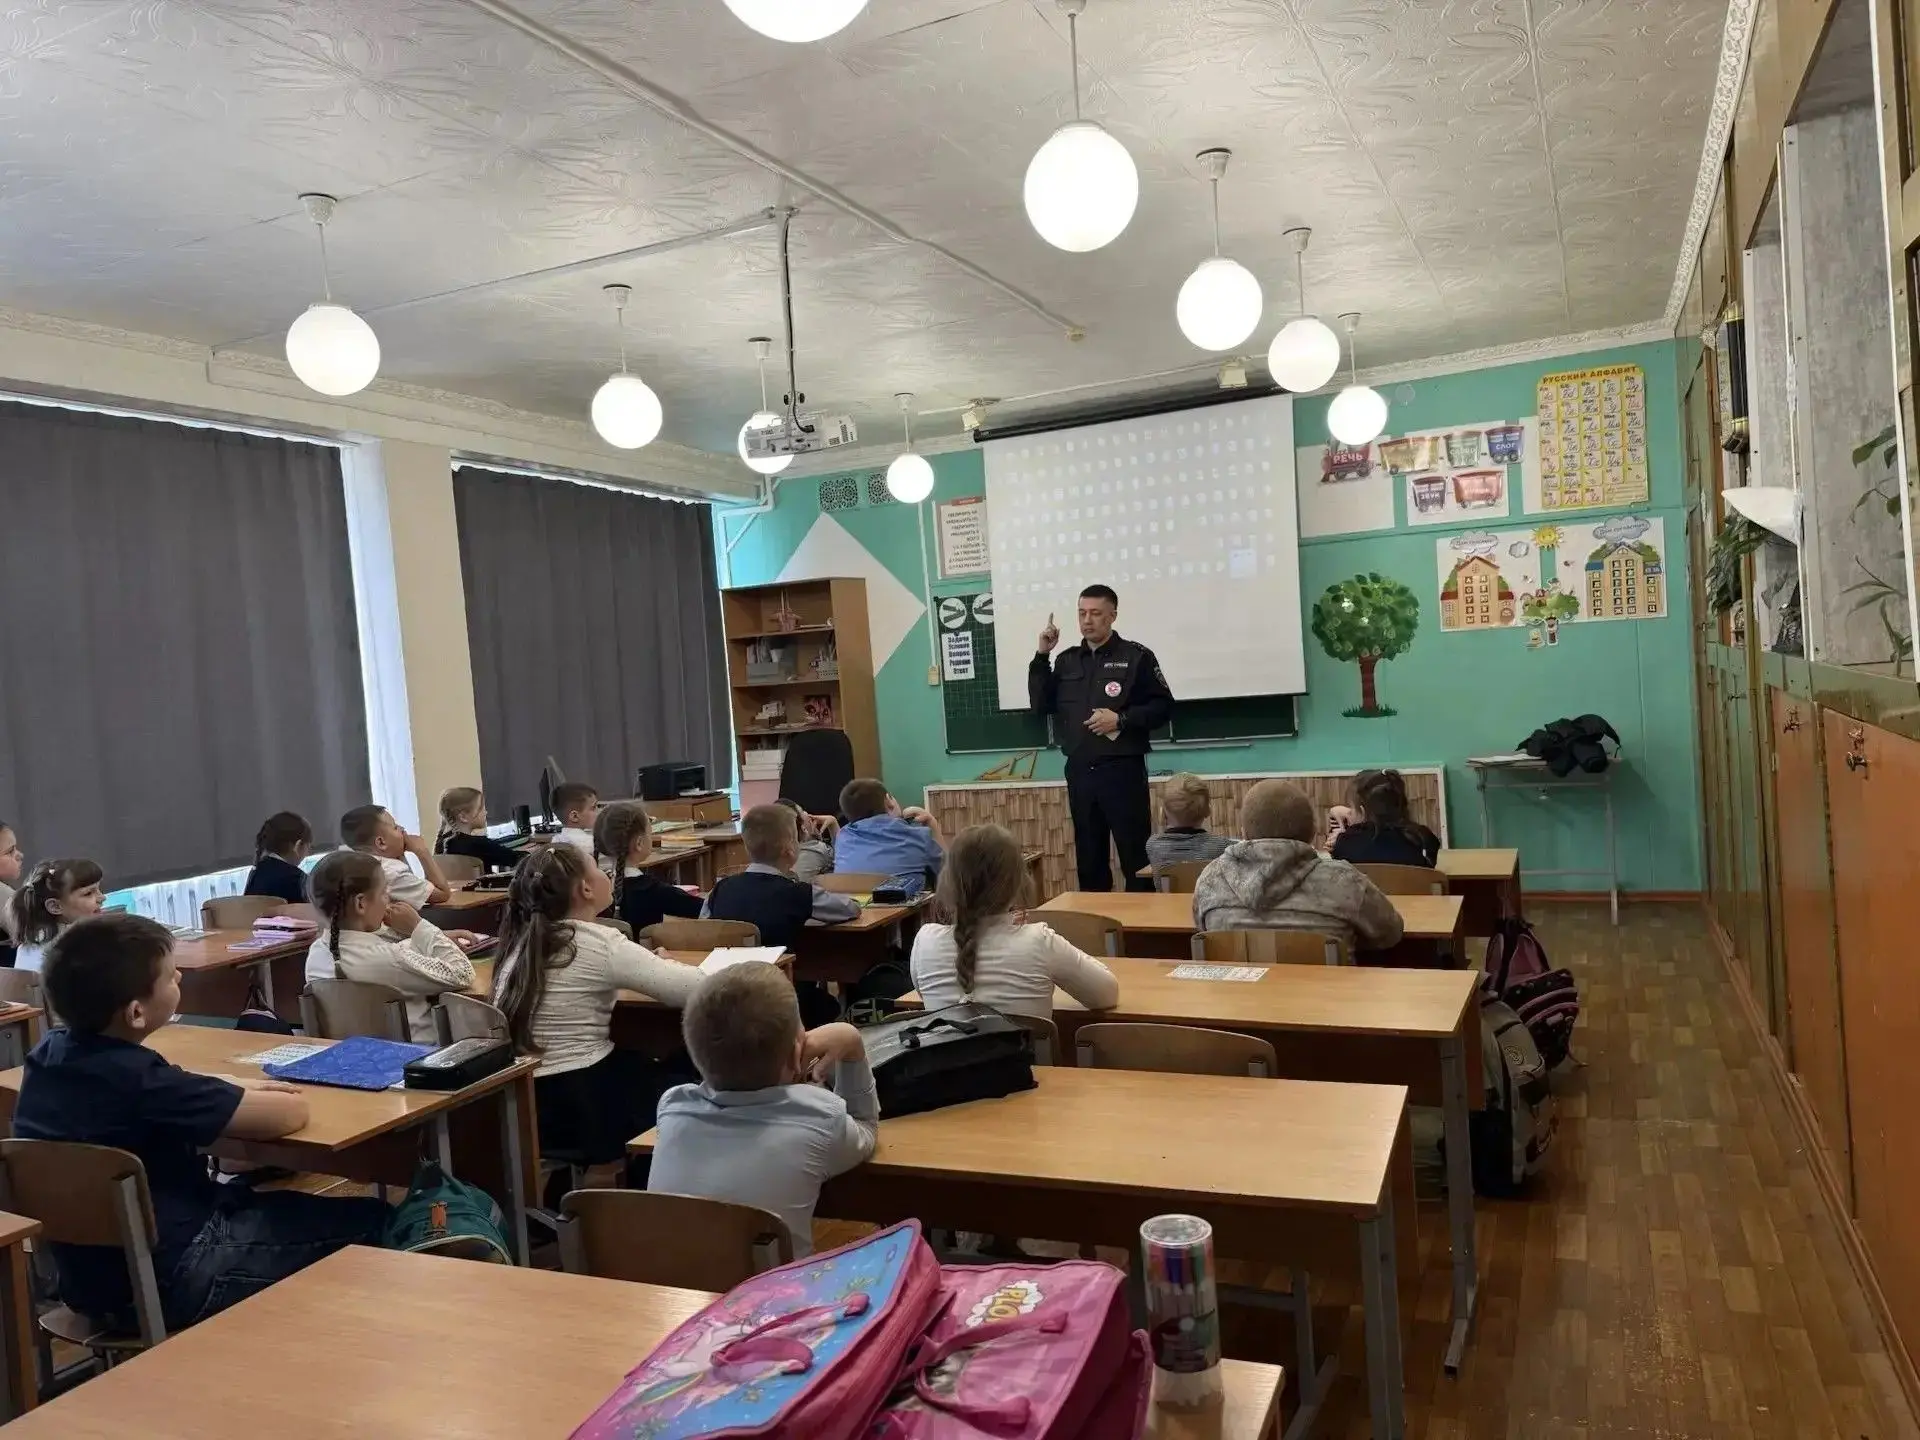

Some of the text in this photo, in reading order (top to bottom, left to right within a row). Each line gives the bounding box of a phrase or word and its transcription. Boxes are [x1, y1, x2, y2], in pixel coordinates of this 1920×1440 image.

[1543, 366, 1636, 383] РУССКИЙ АЛФАВИТ
[1495, 442, 1515, 450] СЛОГ
[1333, 453, 1364, 464] РЕЧЬ
